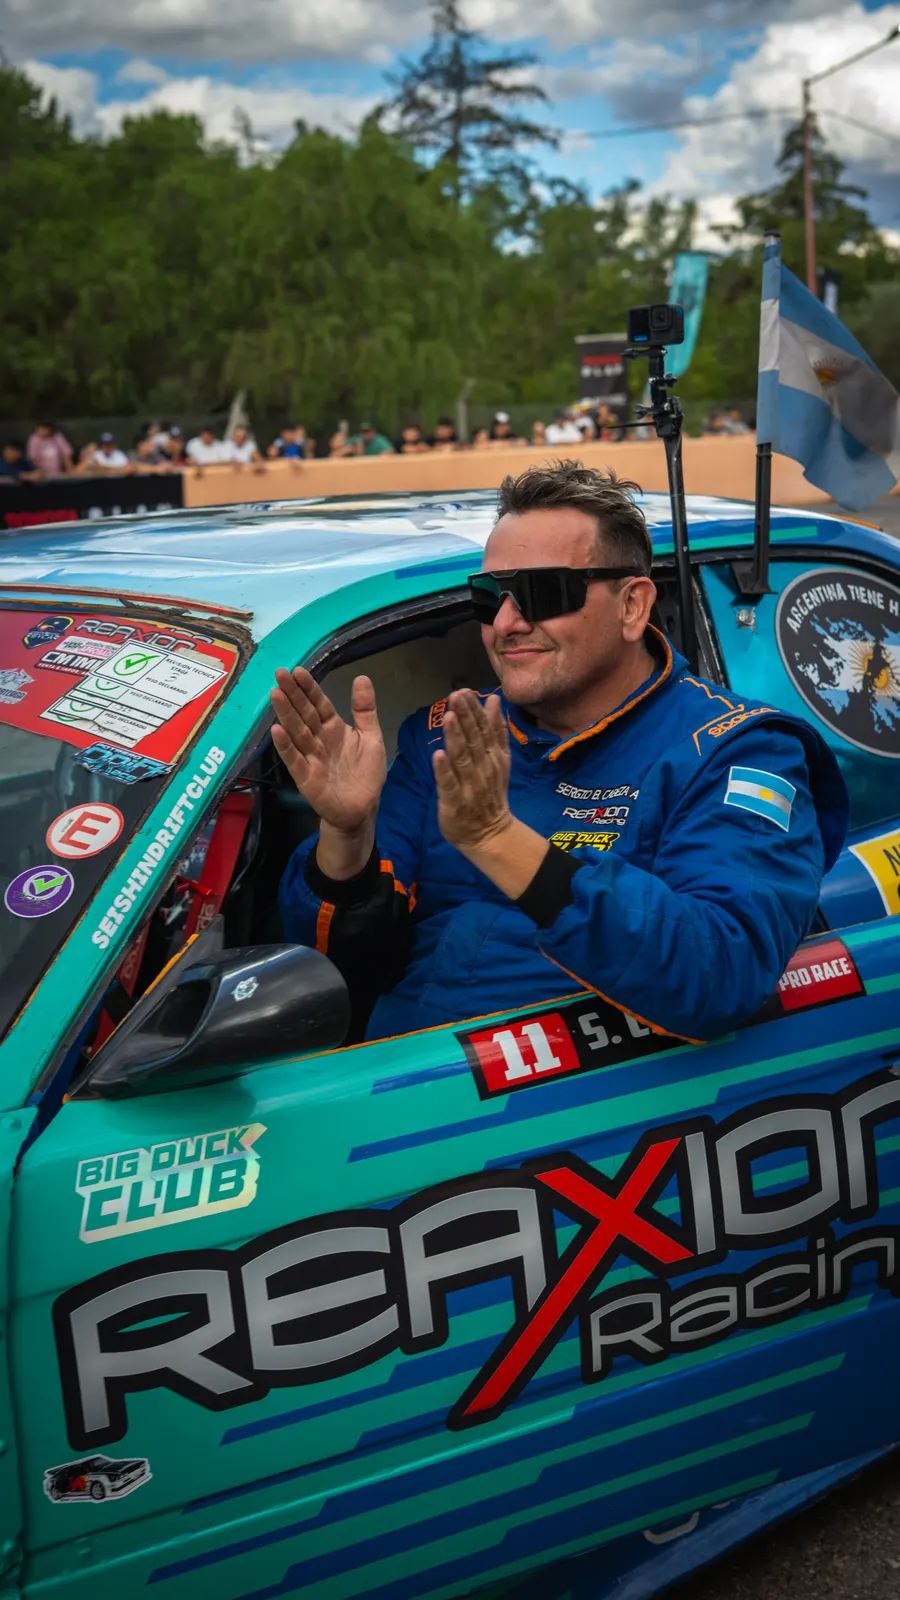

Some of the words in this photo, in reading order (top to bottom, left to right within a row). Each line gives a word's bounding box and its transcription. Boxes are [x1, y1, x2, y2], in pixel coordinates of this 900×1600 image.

[786, 582, 848, 635] ARGENTINA
[848, 584, 885, 610] TIENE
[889, 598, 900, 617] H
[145, 676, 158, 684] PESO
[157, 681, 189, 695] DECLARADO
[170, 665, 189, 675] STAGE
[192, 667, 217, 680] TECNICA
[555, 782, 592, 800] SERGIO
[58, 810, 112, 851] E
[562, 806, 630, 825] REAXION
[592, 817, 627, 826] Racing
[91, 746, 226, 949] SEISHINDRIFTCLUB
[551, 833, 576, 841] BIG
[575, 833, 612, 843] DUCK
[882, 844, 900, 876] N
[778, 965, 811, 992] PRO
[812, 957, 852, 982] RACE
[492, 1021, 562, 1082] 11
[578, 1011, 623, 1051] S.
[79, 1151, 139, 1188] BIG
[151, 1127, 250, 1173] DUCK
[85, 1157, 248, 1232] CLUB
[590, 1236, 898, 1373] Racin
